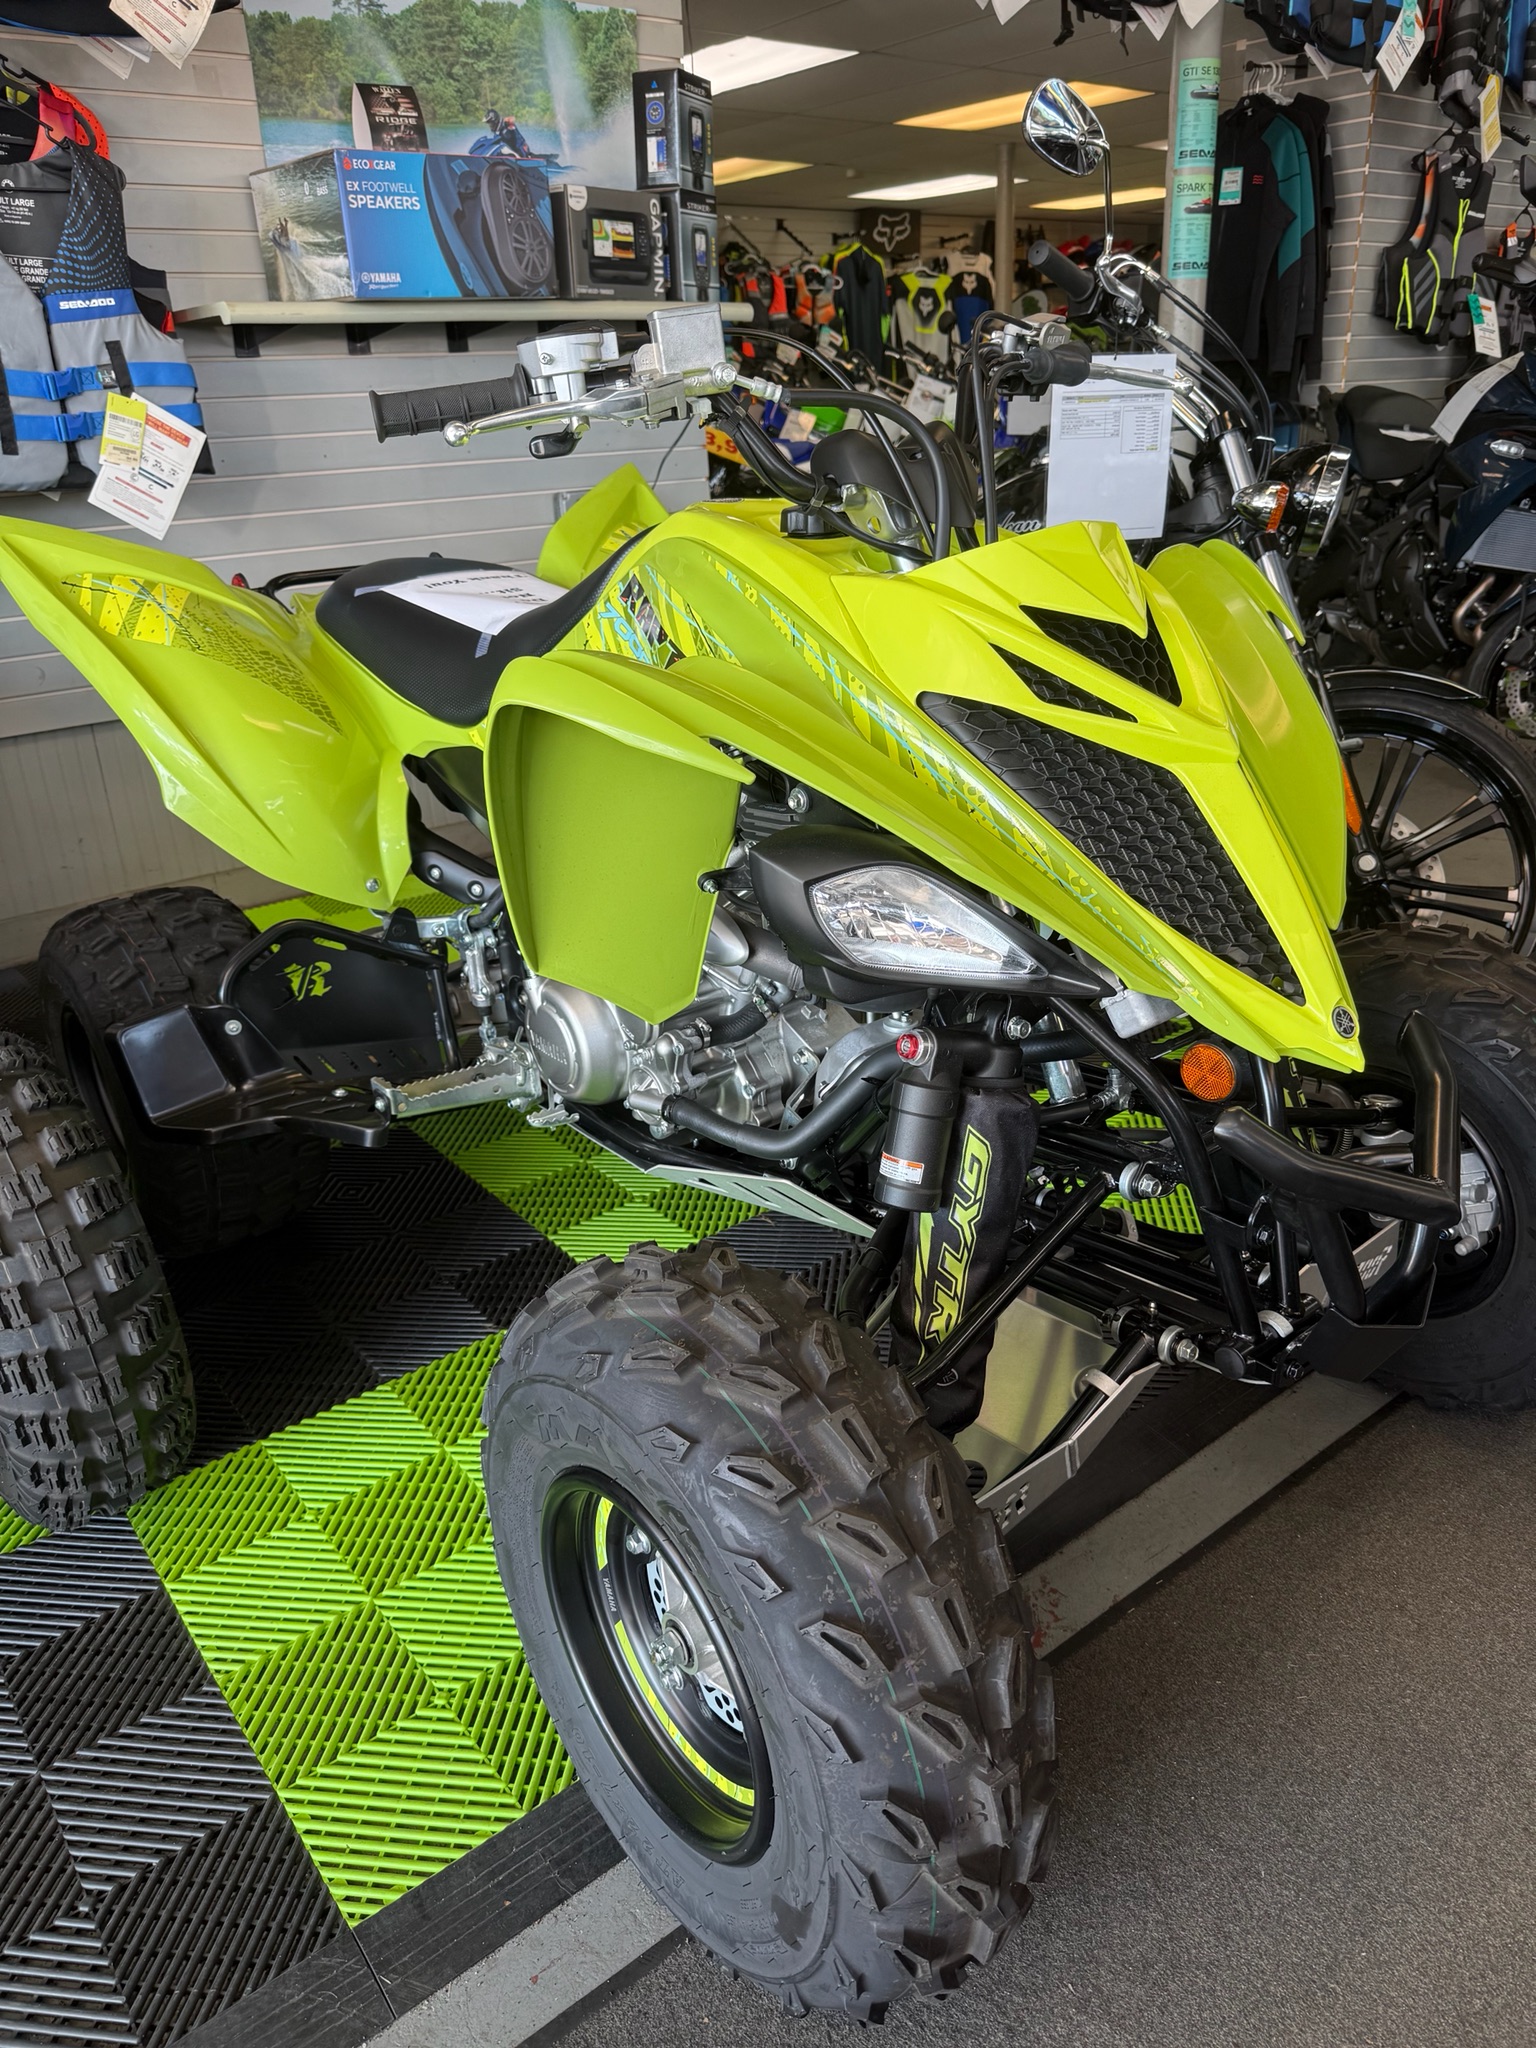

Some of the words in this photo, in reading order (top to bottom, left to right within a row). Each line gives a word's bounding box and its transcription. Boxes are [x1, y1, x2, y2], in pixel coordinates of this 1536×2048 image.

[346, 181, 359, 192] EX
[362, 181, 416, 194] FOOTWELL
[1176, 183, 1206, 194] SPARK
[10, 197, 36, 208] LARGE
[348, 194, 421, 210] SPEAKERS
[19, 258, 44, 268] LARGE
[370, 272, 402, 284] YAMAHA
[924, 1124, 993, 1347] GYTR
[602, 1576, 618, 1613] YAMAHA
